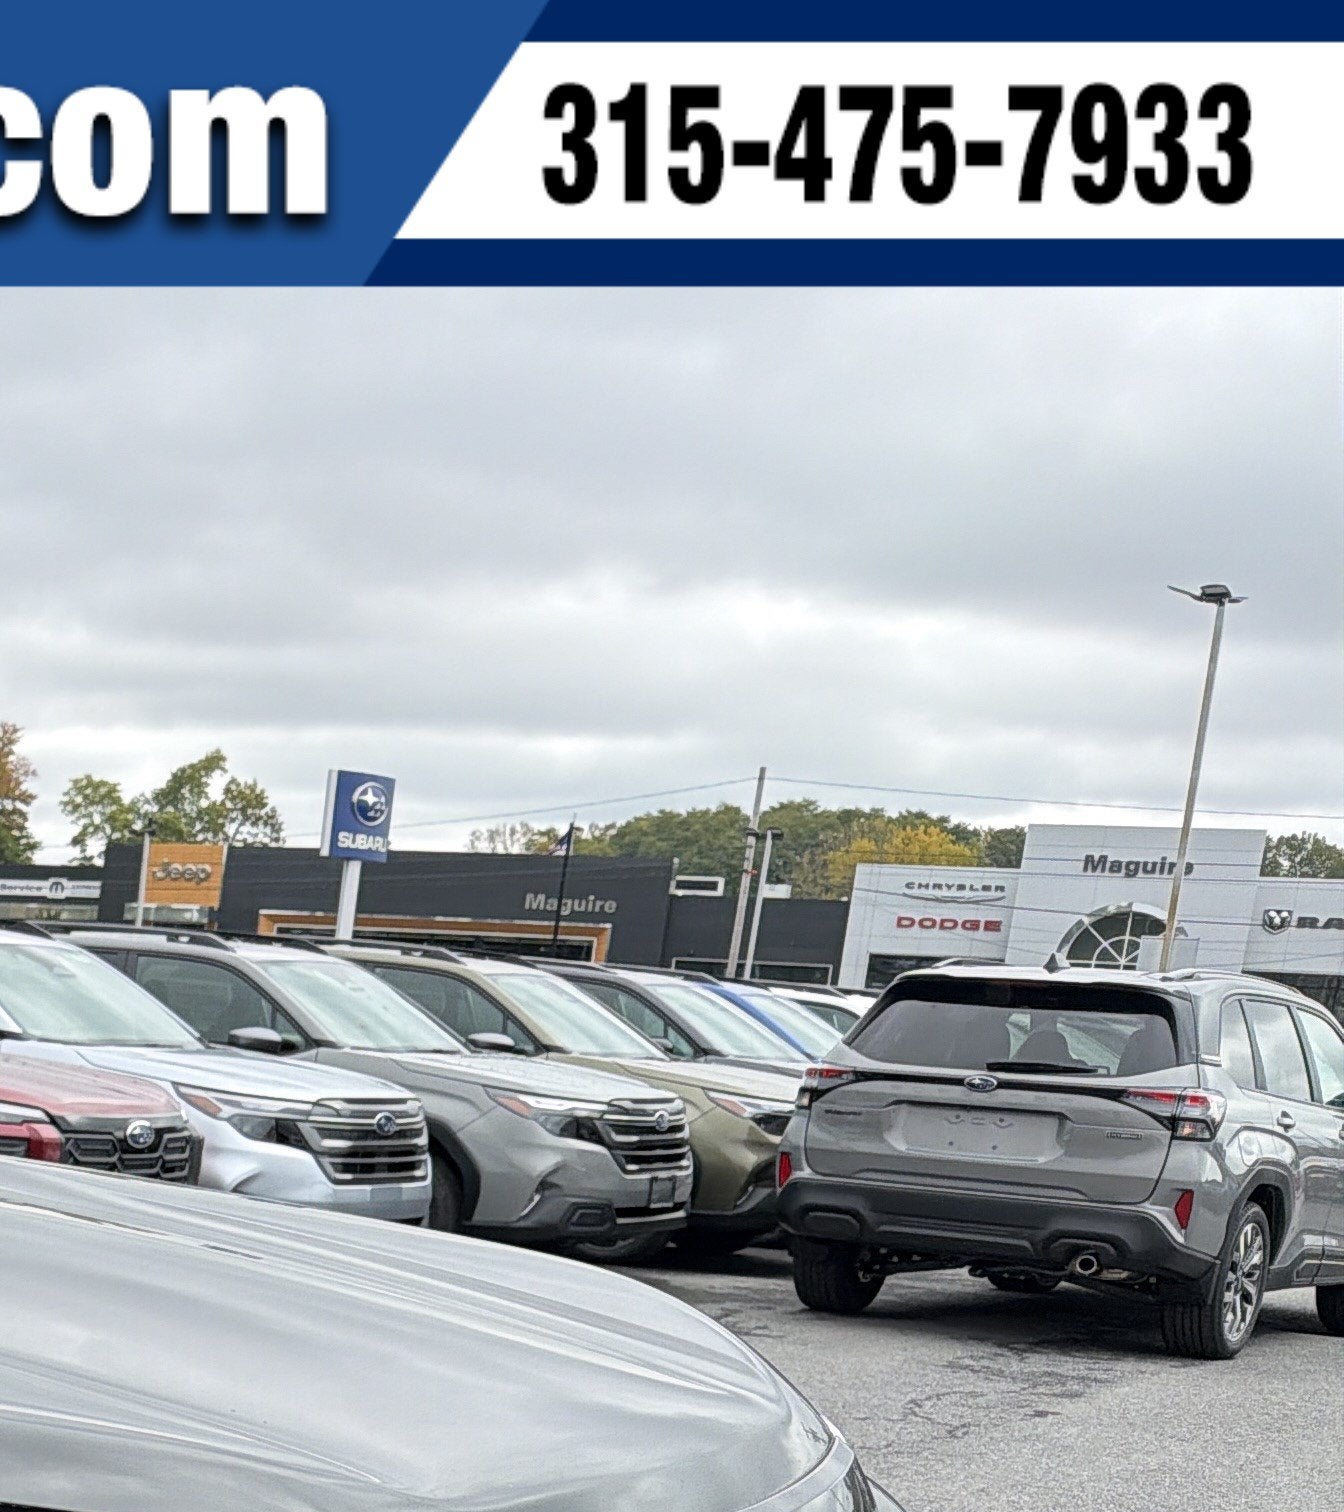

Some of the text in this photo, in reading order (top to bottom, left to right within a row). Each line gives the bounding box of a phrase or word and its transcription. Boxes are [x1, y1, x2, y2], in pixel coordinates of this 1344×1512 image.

[337, 831, 387, 853] SUBARU
[153, 859, 211, 884] Jeep
[904, 881, 1006, 892] CHRYSLER
[524, 893, 618, 915] Maguire
[895, 916, 1002, 932] DODGE
